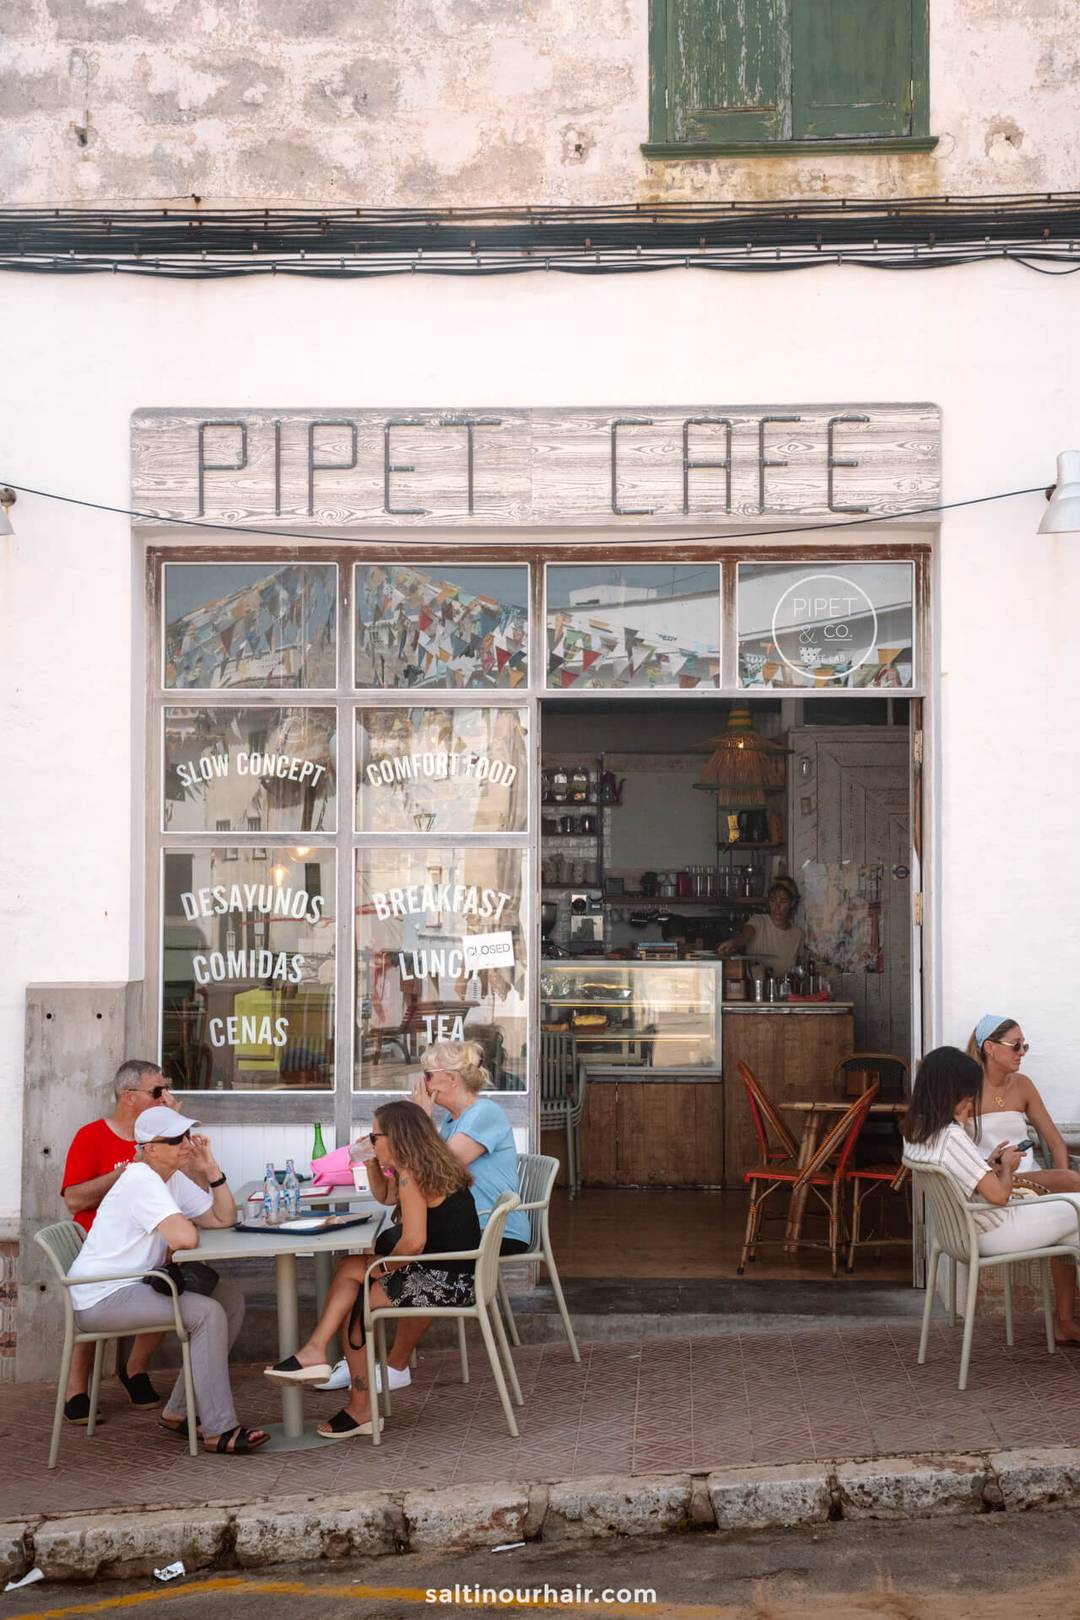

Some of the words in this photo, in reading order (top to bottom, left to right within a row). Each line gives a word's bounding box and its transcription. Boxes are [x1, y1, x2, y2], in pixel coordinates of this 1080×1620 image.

[199, 419, 501, 517] PIPET
[611, 415, 870, 515] CAFE
[793, 598, 858, 617] PIPET
[799, 624, 818, 644] &
[176, 752, 230, 787] SLOW
[236, 752, 326, 787] CONCEPT
[366, 752, 458, 787] COMFORT
[464, 754, 517, 787] FOOD
[180, 884, 325, 924] DESAYUNOS
[372, 883, 511, 921] BREAKFAST
[192, 950, 305, 984] COMIDAS
[466, 943, 511, 957] CLOSED
[209, 1015, 289, 1047] CENAS
[422, 1015, 465, 1044] TEA
